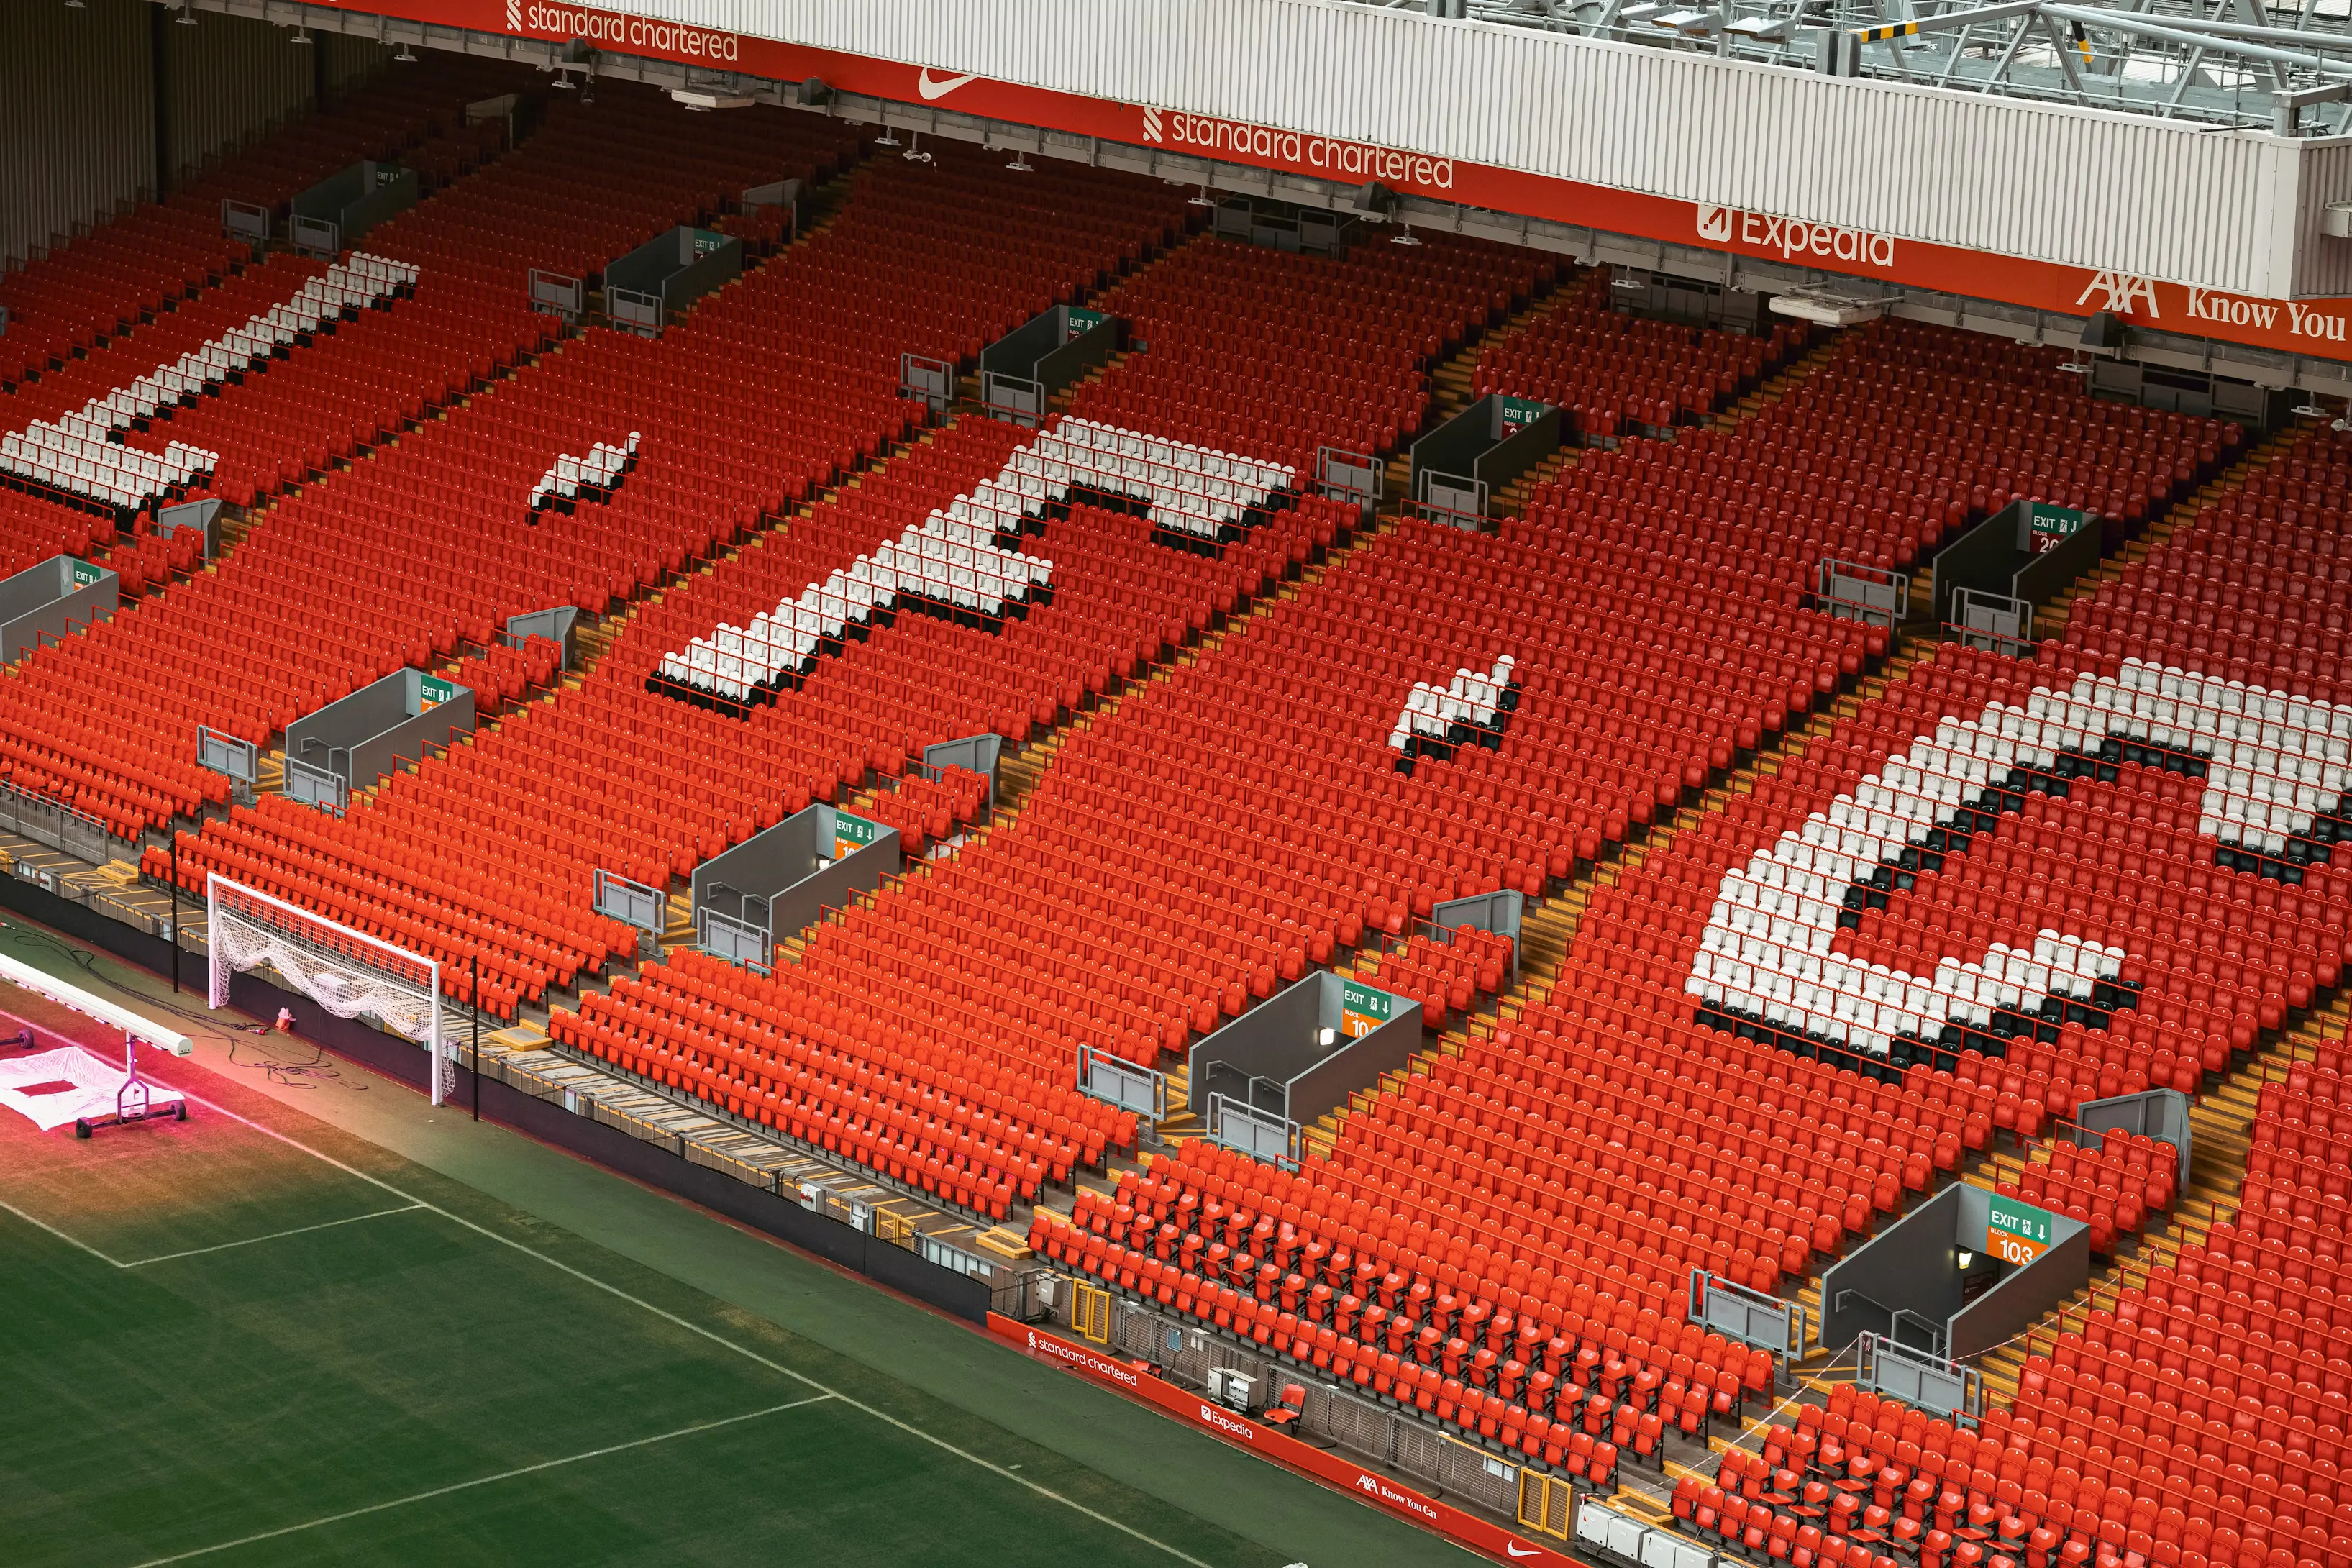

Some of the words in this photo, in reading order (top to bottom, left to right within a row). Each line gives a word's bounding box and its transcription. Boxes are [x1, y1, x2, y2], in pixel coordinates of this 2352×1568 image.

[529, 1, 624, 43] standard
[630, 17, 738, 61] chartered
[1172, 113, 1301, 163] standard
[1308, 137, 1453, 189] chartered
[377, 171, 388, 181] EXIT
[695, 238, 708, 249] EXIT
[1741, 210, 1895, 268] Expedia
[2075, 271, 2161, 319] AXA
[1069, 317, 1085, 329] EXIT
[2186, 286, 2279, 330] Know
[2285, 301, 2346, 342] You
[1504, 407, 1522, 421] EXIT
[2033, 515, 2056, 529] EXIT
[76, 570, 88, 582] EXIT
[422, 685, 437, 699] EXIT
[837, 819, 853, 833] EXIT
[1344, 989, 1364, 1005] EXIT
[1344, 1009, 1359, 1018] BLOCK
[1991, 1210, 2019, 1231] EXIT
[1990, 1226, 2009, 1238] BLOCK
[2000, 1239, 2033, 1266] 103
[1039, 1339, 1086, 1365] standard
[1088, 1358, 1138, 1387] chartered
[1212, 1410, 1253, 1439] Expedia
[1355, 1474, 1379, 1495] AXA
[1381, 1485, 1406, 1505] Know
[1406, 1496, 1422, 1513] You
